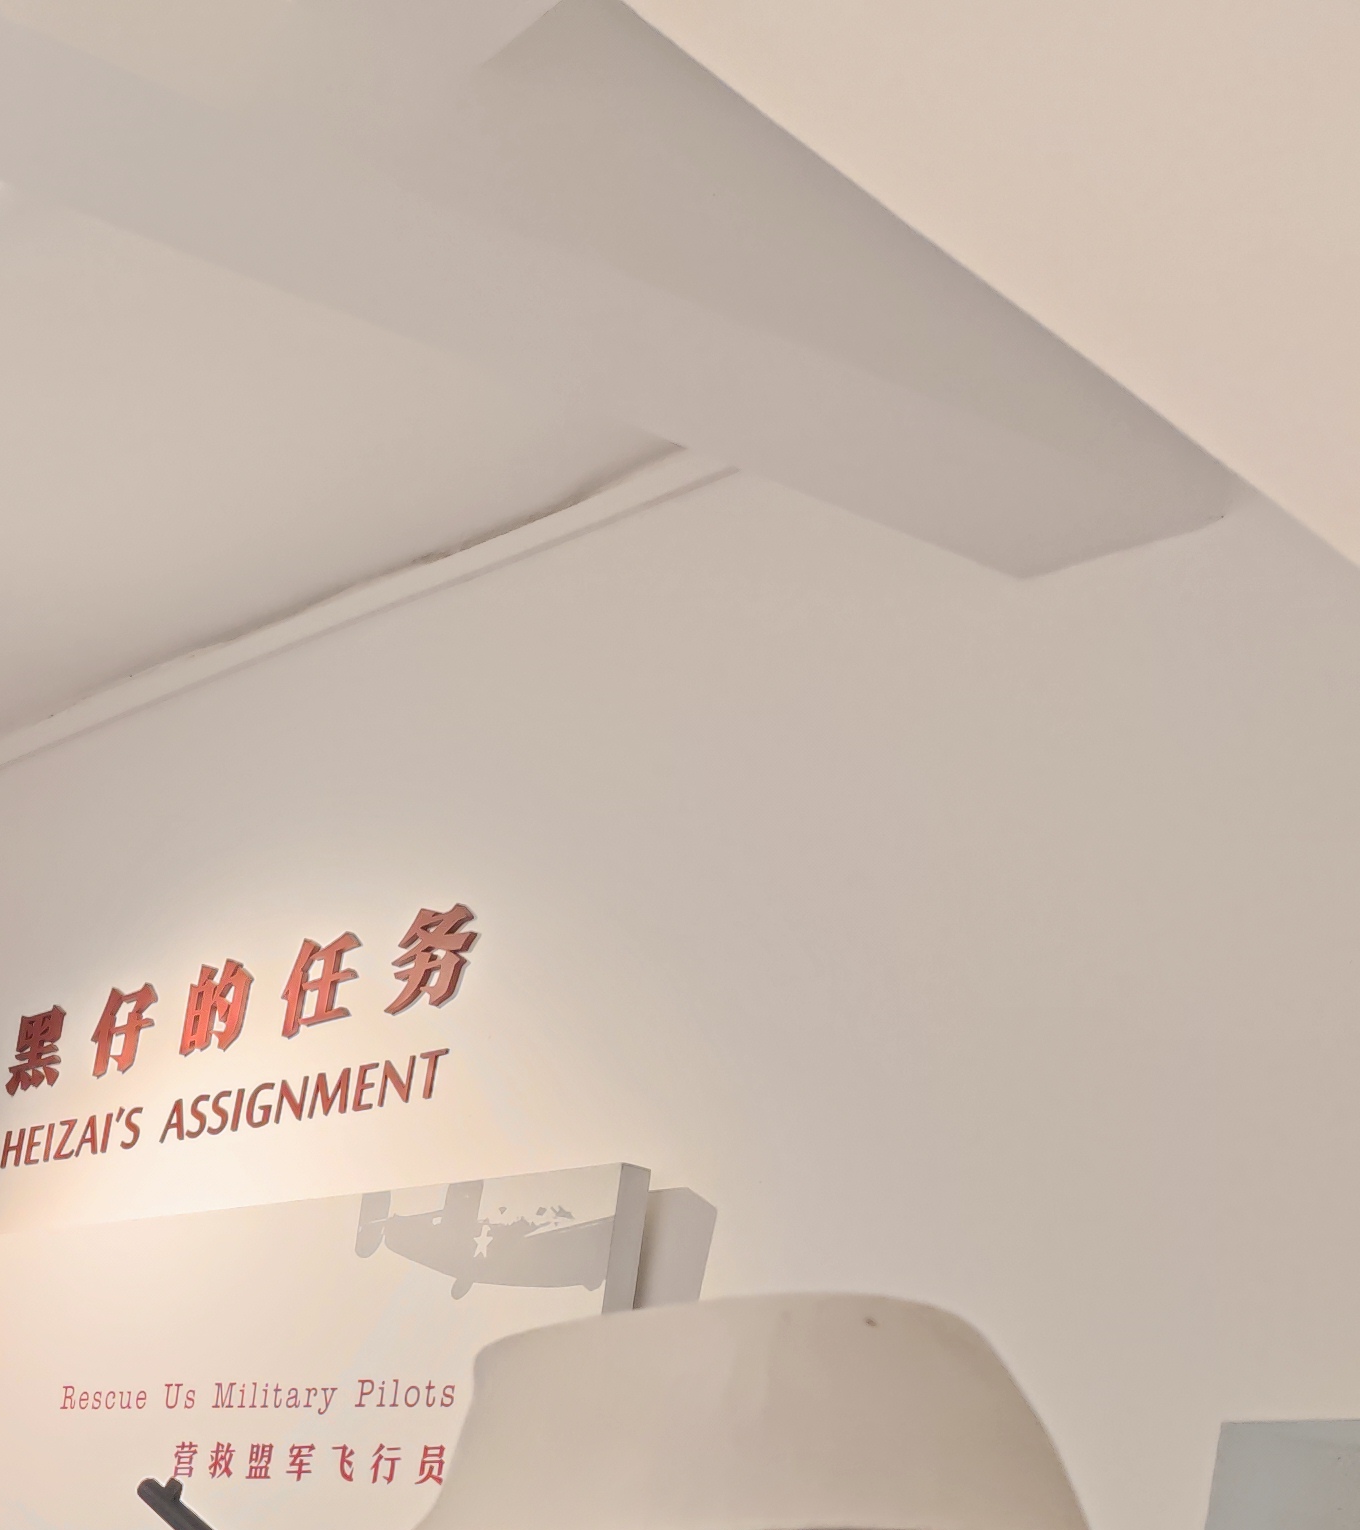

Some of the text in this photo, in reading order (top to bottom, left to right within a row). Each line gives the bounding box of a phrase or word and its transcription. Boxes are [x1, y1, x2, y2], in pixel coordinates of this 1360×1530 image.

[5, 902, 480, 1097] 黑仔的任务
[0, 1047, 450, 1169] HEIZAI'S ASSIGNMENT
[59, 1378, 457, 1416] Rescue Us Military Pilots
[170, 1440, 447, 1486] 营救盟军飞行员
